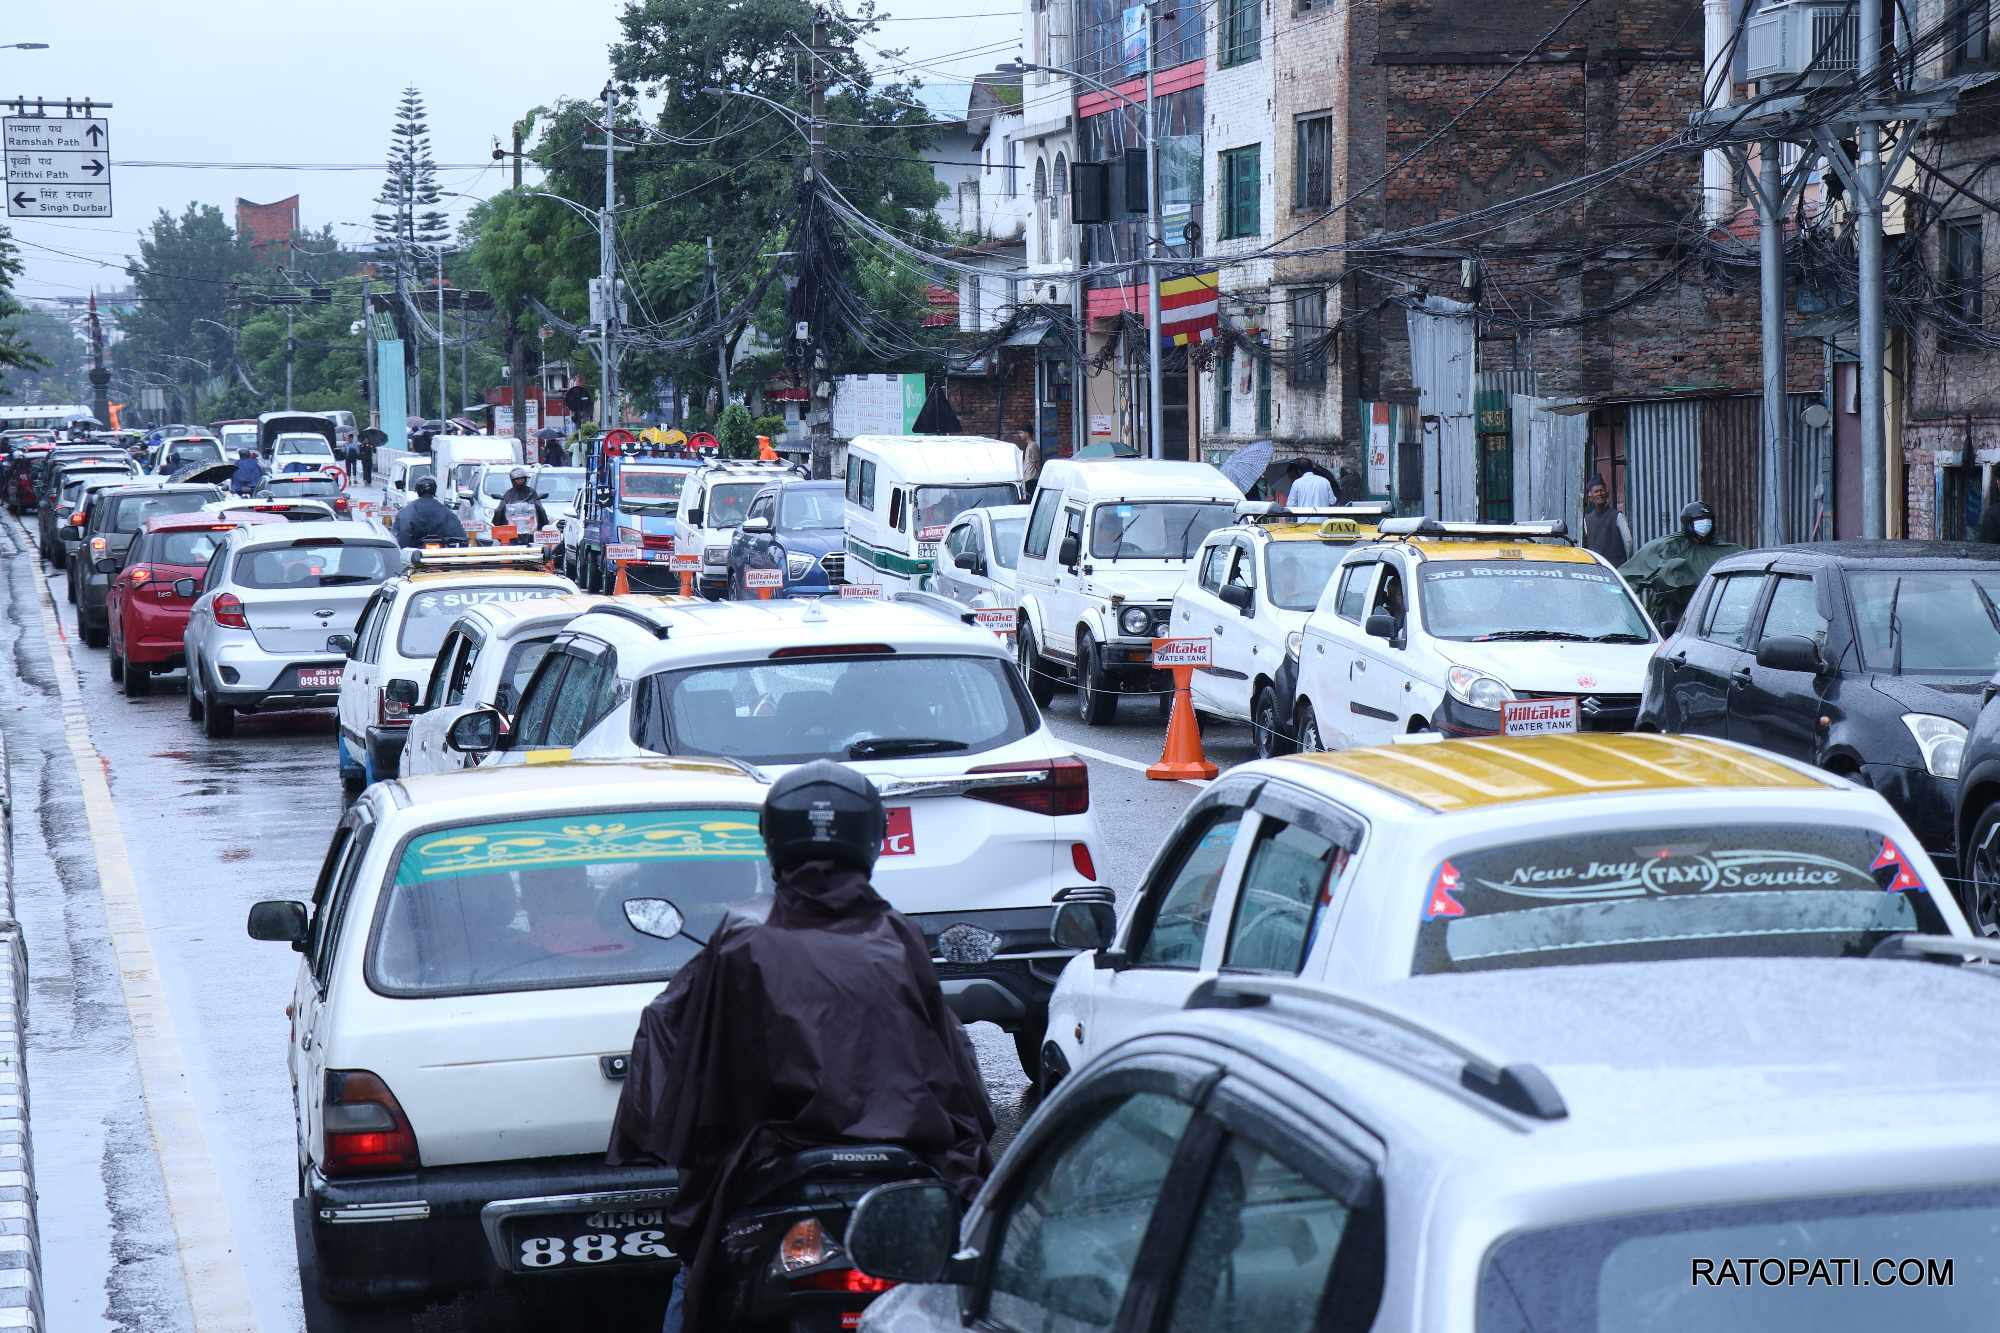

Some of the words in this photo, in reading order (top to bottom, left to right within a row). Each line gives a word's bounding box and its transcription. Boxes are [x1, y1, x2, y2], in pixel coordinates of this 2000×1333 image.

[48, 125, 62, 133] पथ
[9, 138, 53, 146] Ramshah
[57, 138, 80, 146] Path
[10, 171, 42, 179] Prithvi
[47, 171, 68, 179] Path
[40, 204, 69, 213] Singh
[73, 204, 107, 212] Durbar
[1329, 523, 1356, 532] TAXI
[1508, 706, 1570, 721] Hilltake
[1510, 723, 1543, 732] WATER
[1545, 721, 1572, 730] TANK
[1504, 866, 1575, 885] New
[1579, 861, 1641, 882] Jay
[1721, 866, 1840, 887] Service
[832, 1153, 889, 1162] HONDA
